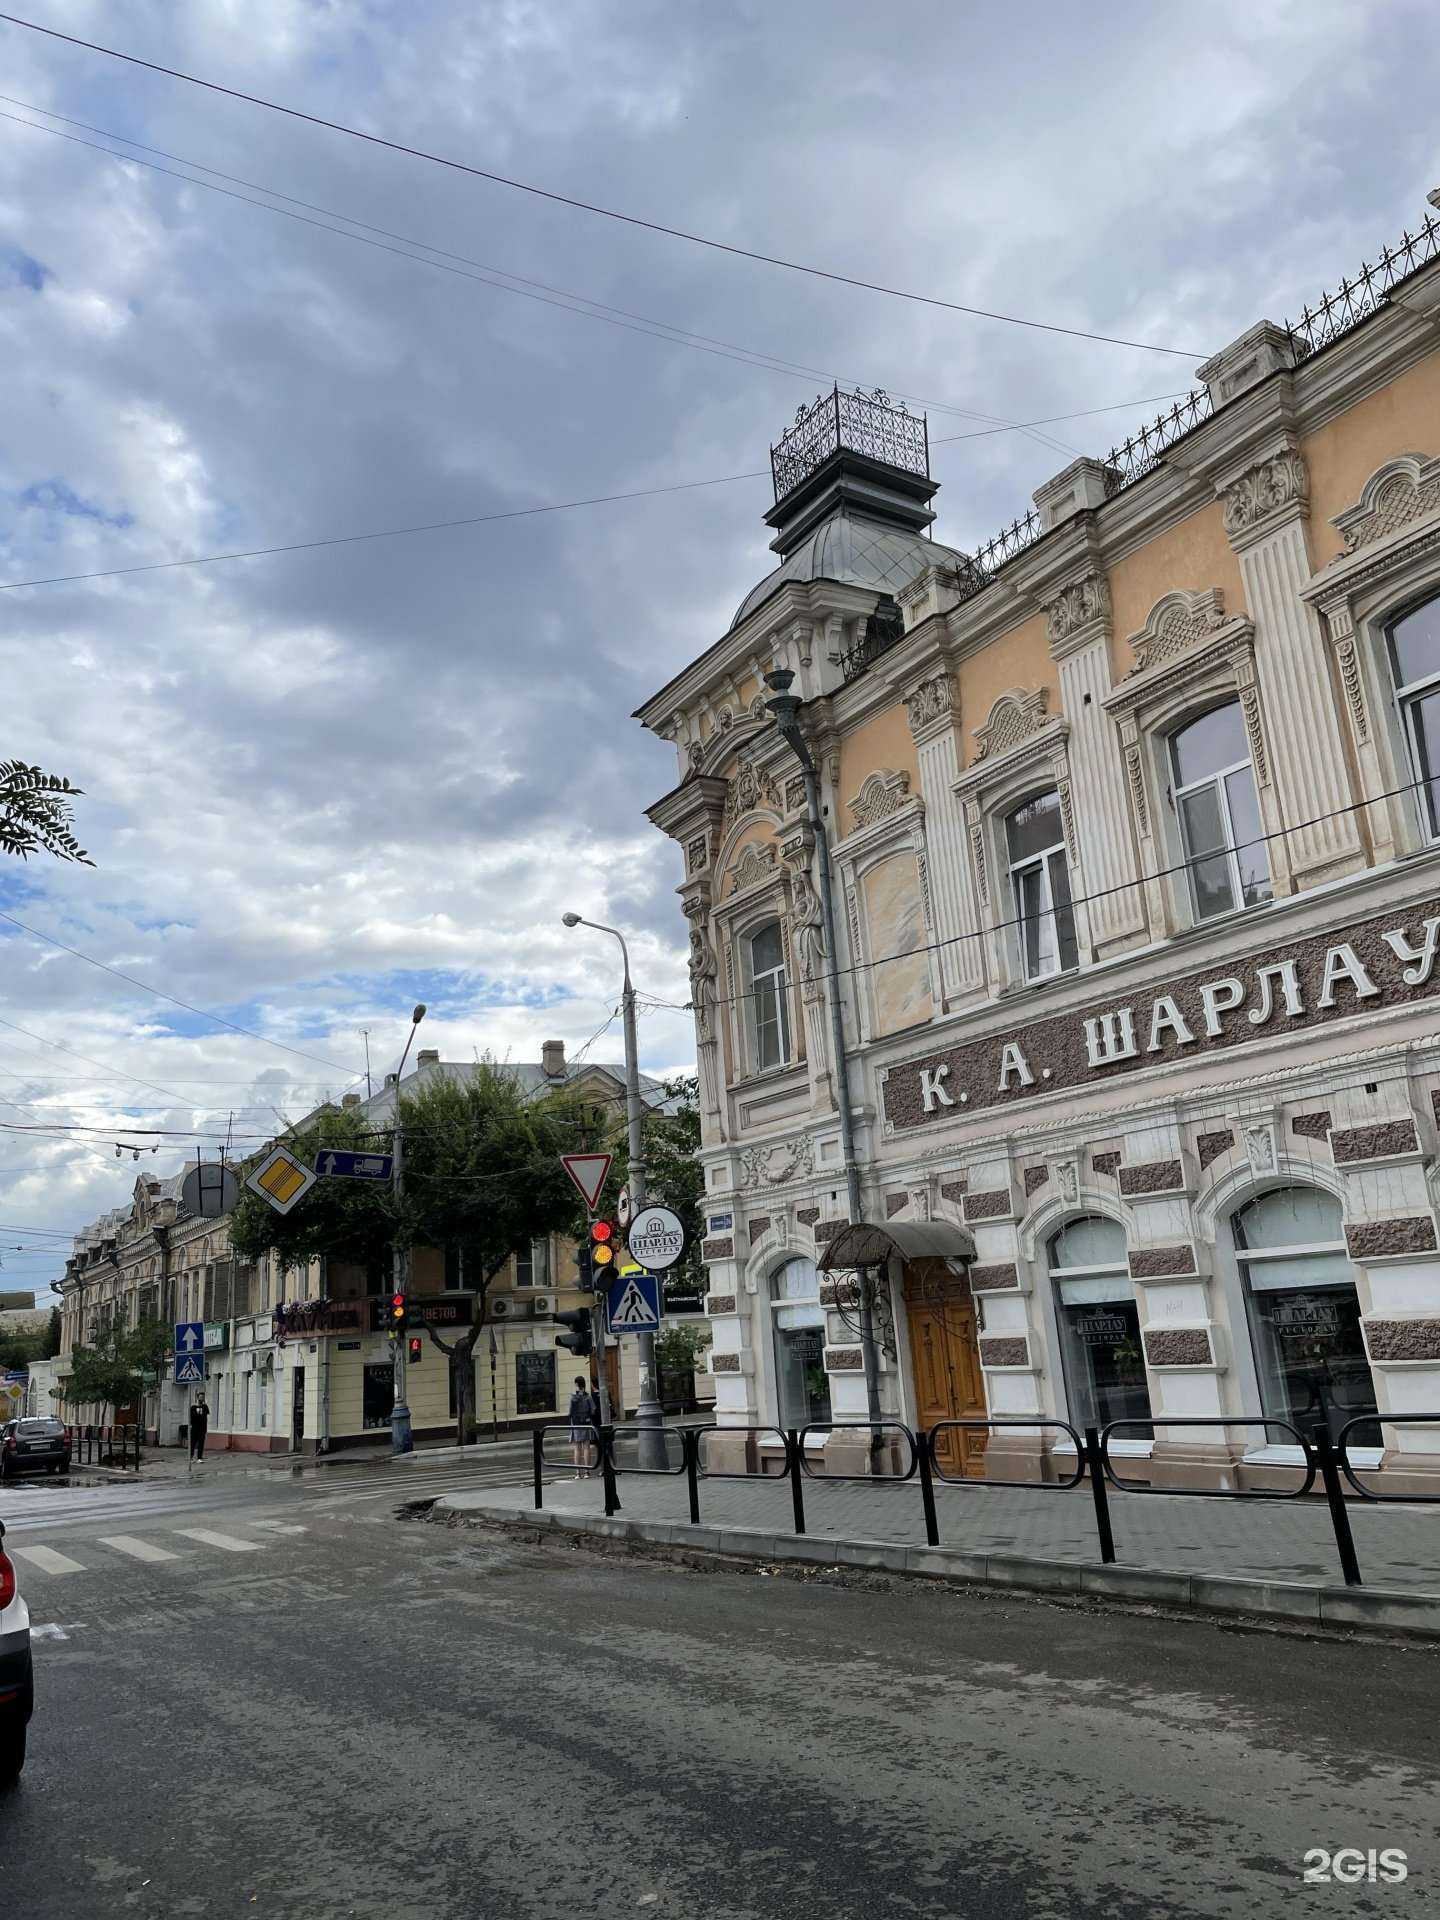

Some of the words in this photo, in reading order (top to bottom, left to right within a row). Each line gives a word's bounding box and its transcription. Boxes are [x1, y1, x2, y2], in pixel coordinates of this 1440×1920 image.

[920, 1064, 968, 1112] К.
[998, 1042, 1051, 1091] А.
[1083, 916, 1440, 1067] ШАРЛАУ
[632, 1236, 679, 1249] ШАРЛАУ
